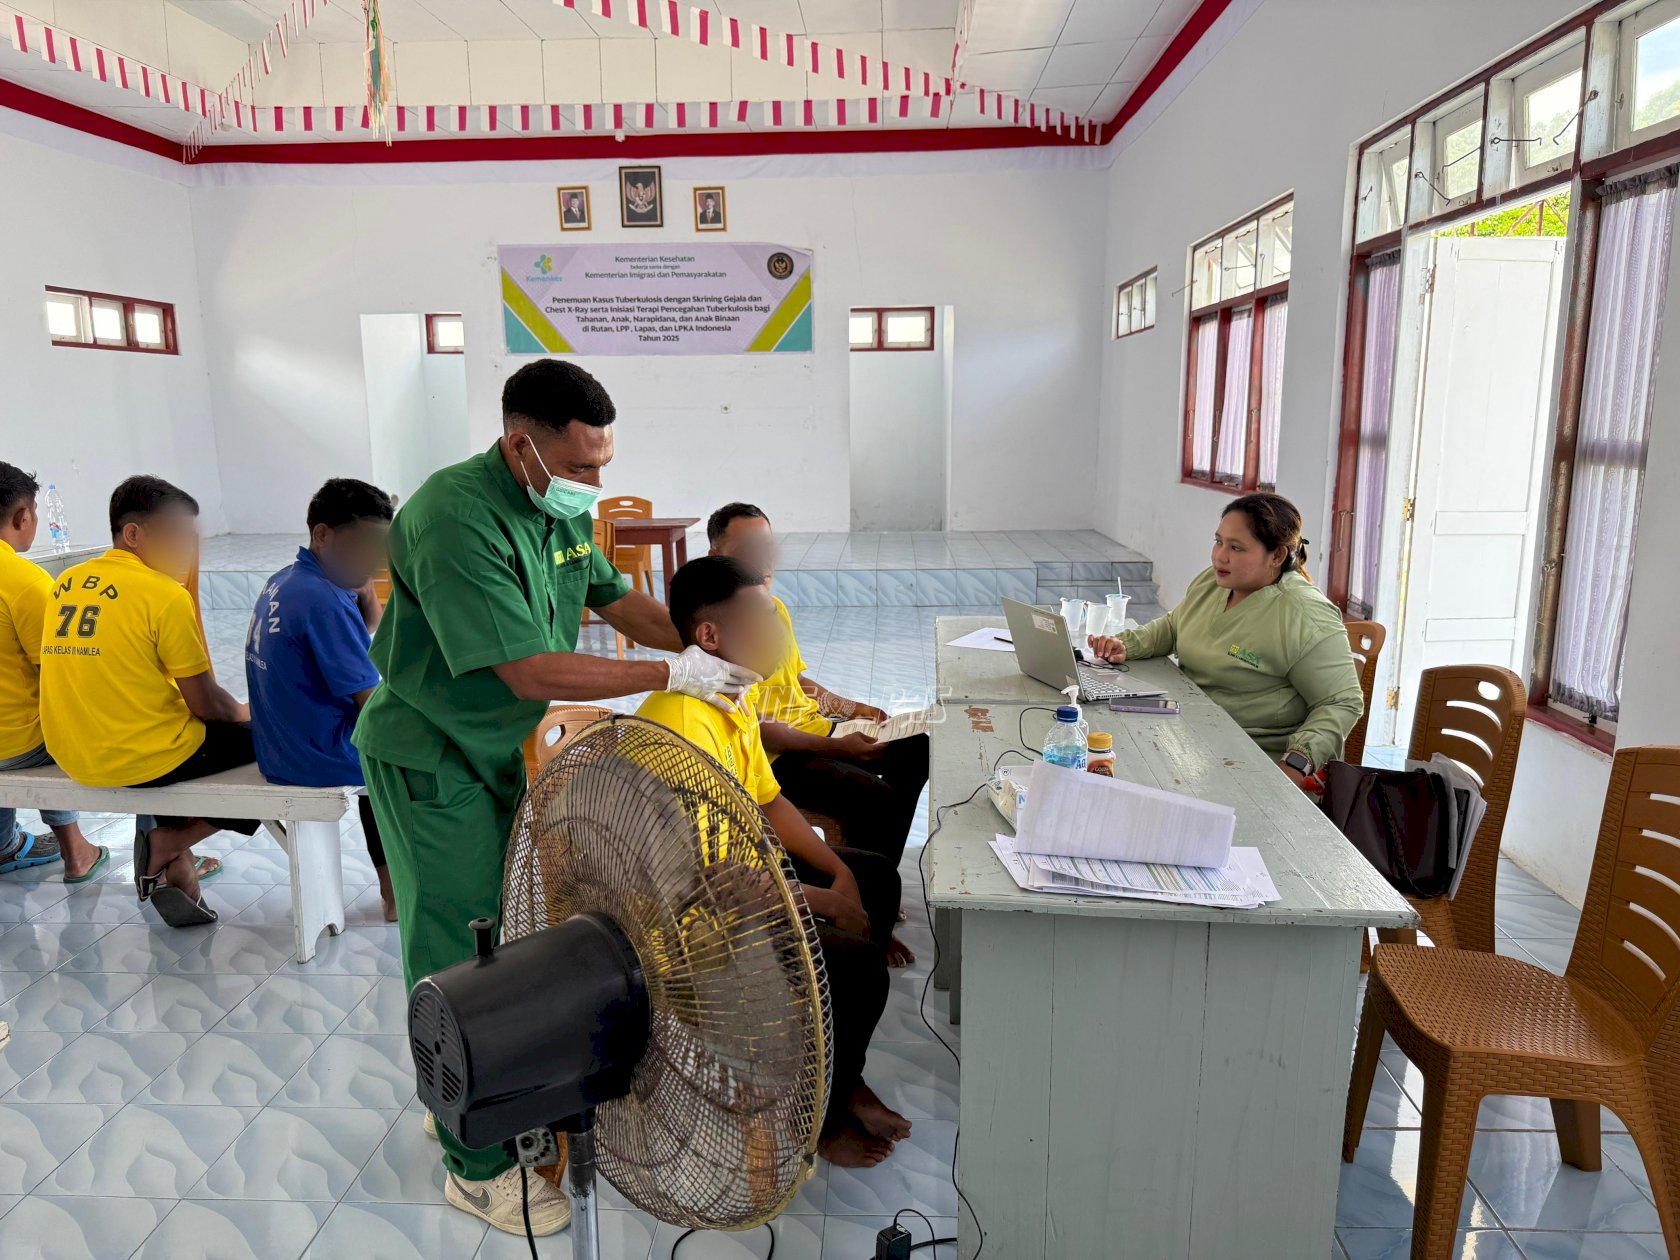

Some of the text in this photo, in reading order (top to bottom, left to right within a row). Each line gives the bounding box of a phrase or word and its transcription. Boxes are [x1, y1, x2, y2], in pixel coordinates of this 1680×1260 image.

[615, 255, 695, 263] Kementerian Kesehatan
[585, 270, 727, 281] Kementerian Imigrasi dan Pemasyarakatan
[552, 294, 762, 305] Penemuan Kasus Tuberkulosis dengan Skrining Gejala dan
[545, 306, 566, 314] Chest
[567, 306, 589, 315] X-Ray
[610, 305, 635, 313] Inisiasi
[636, 305, 659, 315] Terapi
[660, 305, 705, 314] Pencegahan
[706, 304, 753, 313] Tuberkulosis
[754, 304, 771, 313] bagi
[576, 315, 610, 324] Tahanan,
[611, 315, 632, 324] Anak,
[633, 315, 678, 324] Narapidana,
[694, 314, 713, 322] Anak
[714, 314, 740, 322] Binaan
[582, 325, 590, 333] di
[590, 325, 615, 333] Rutan,
[634, 325, 658, 333] Lapas,
[674, 324, 694, 332] LPKA
[695, 324, 732, 332] Indonesia
[662, 334, 680, 342] 2025
[55, 604, 102, 639] 76
[53, 645, 72, 655] KELAS
